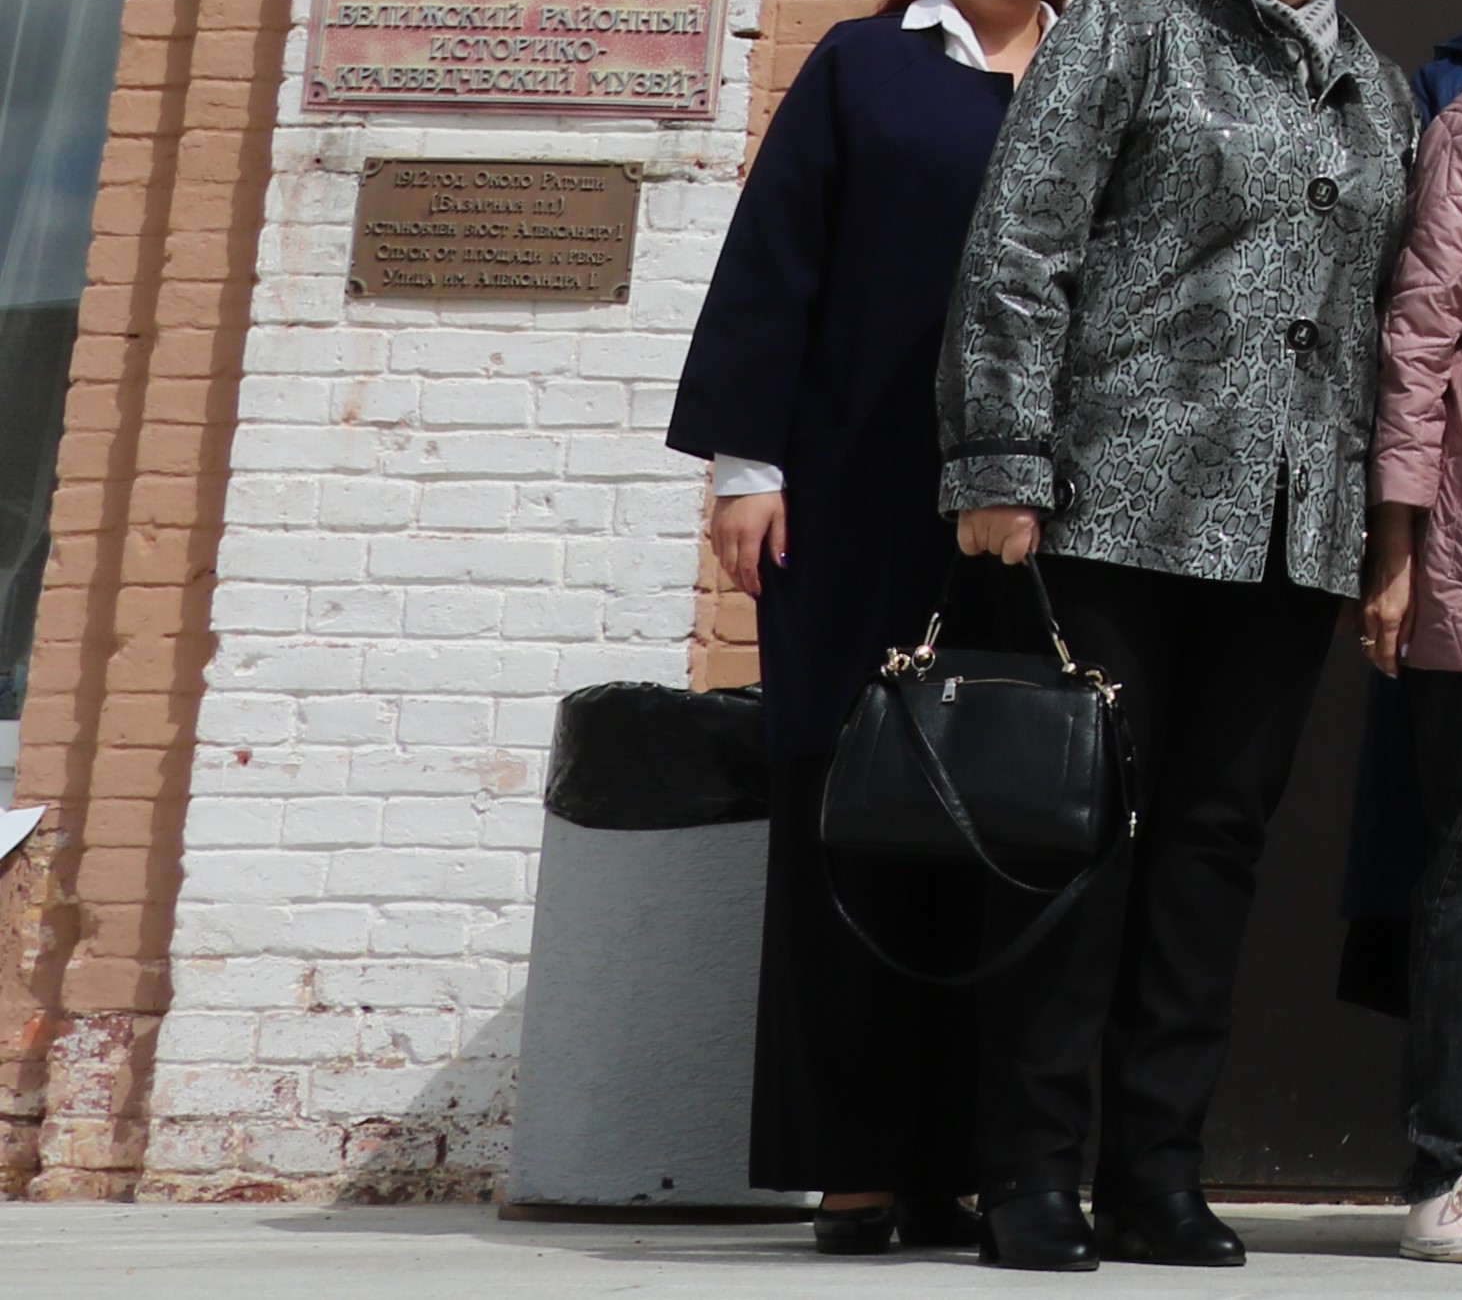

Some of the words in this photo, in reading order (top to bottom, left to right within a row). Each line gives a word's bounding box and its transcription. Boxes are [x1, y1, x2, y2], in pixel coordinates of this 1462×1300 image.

[538, 5, 705, 35] РАЙОННЫЙ
[429, 35, 607, 63] ИСТОРИКО-
[334, 66, 575, 94] КРАЕВЕДЧЕСКИЙ
